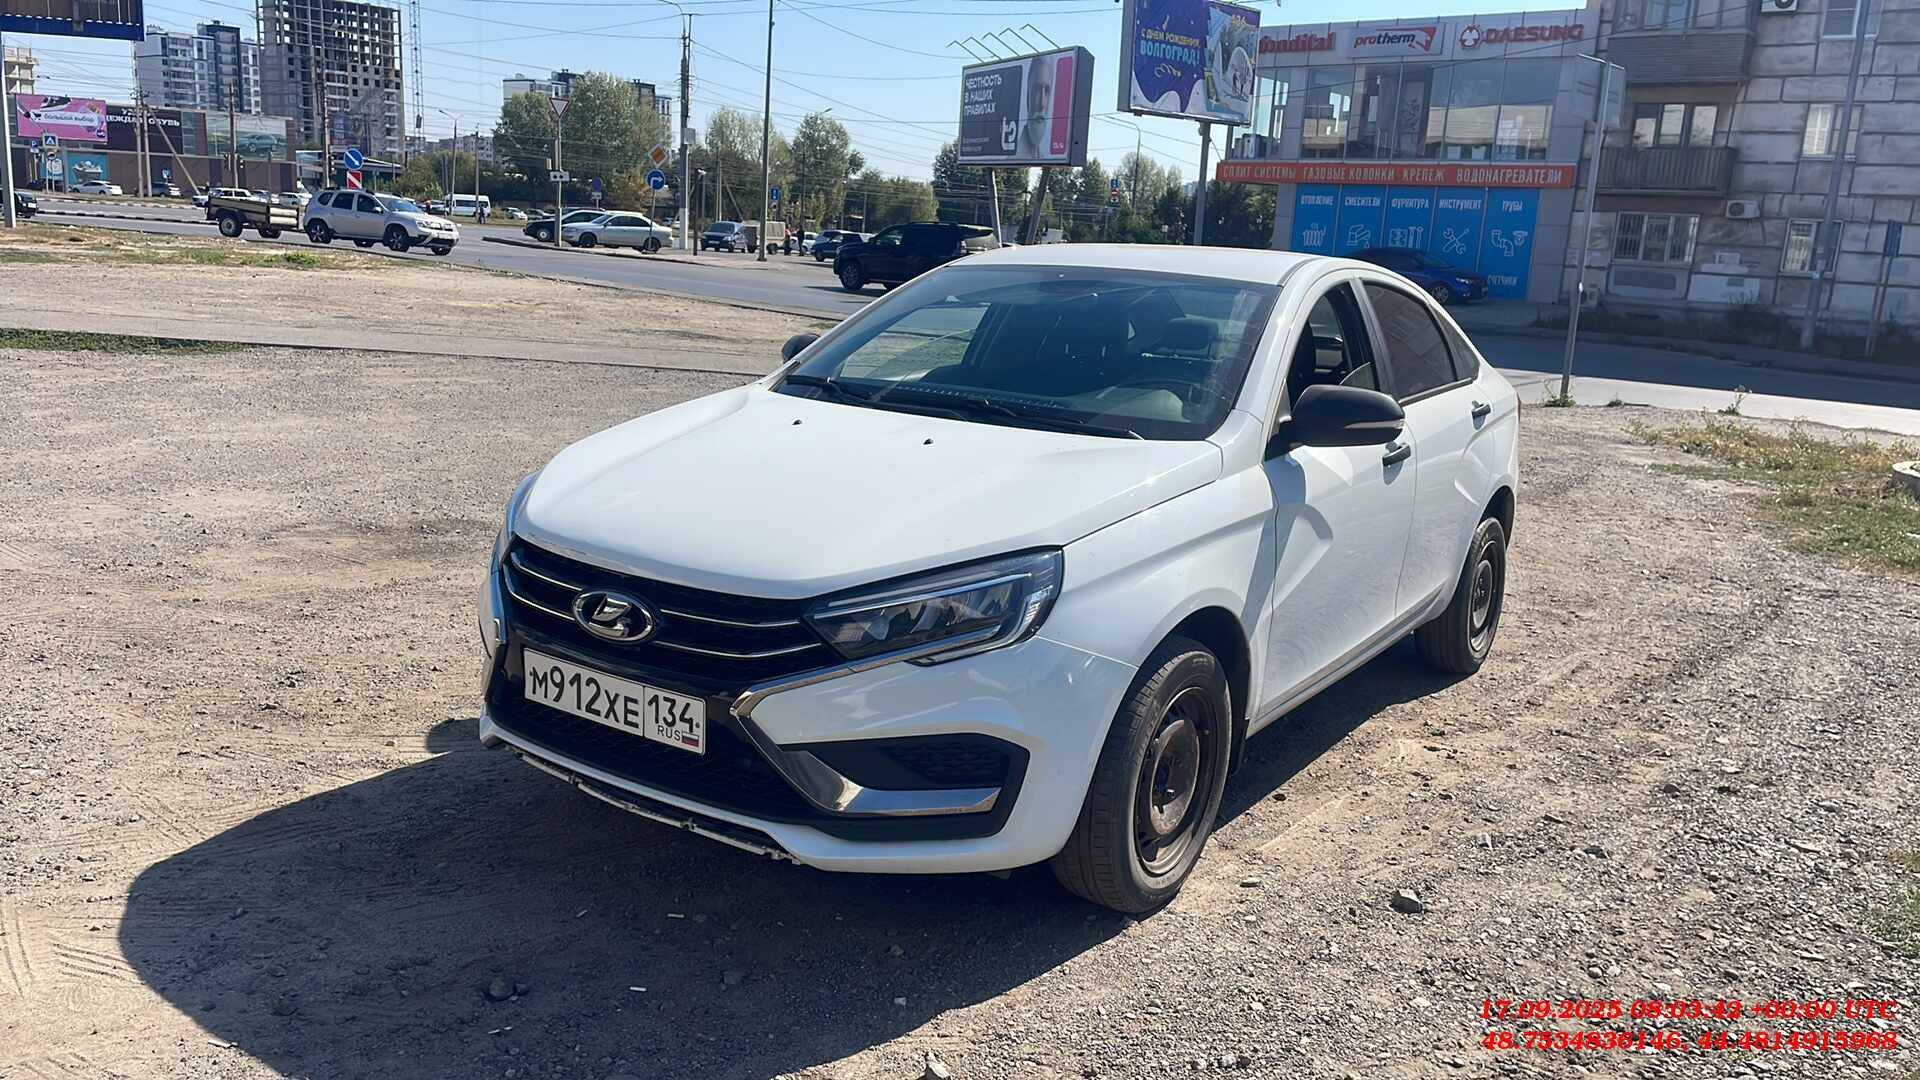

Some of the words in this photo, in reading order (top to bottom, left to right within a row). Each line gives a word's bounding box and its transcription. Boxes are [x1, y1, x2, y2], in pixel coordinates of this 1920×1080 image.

[1354, 33, 1415, 48] protherm
[1485, 24, 1584, 43] DAESUNG
[1140, 41, 1200, 66] ВОЛГОГРАД!
[965, 74, 1002, 89] ЧЕСТНОСТЬ
[970, 90, 993, 102] НАШИХ
[964, 103, 996, 116] ПРАВИЛАХ
[1223, 166, 1250, 178] СПЛИТ
[1254, 166, 1296, 179] СИСТЕМЫ
[1303, 167, 1346, 180] ГАЗОВЫЕ
[1349, 167, 1394, 181] КОЛОНКИ
[1402, 168, 1446, 182] КРЕПЕЖ
[1456, 168, 1562, 184] ВОДОНАГРЕВАТЕЛИ
[1438, 199, 1482, 210] ИНСТРУМЕНТ
[1502, 200, 1523, 212] ТРУБЫ
[531, 665, 640, 729] М912ХЕ
[647, 694, 694, 733] 134
[657, 725, 681, 741] RUS
